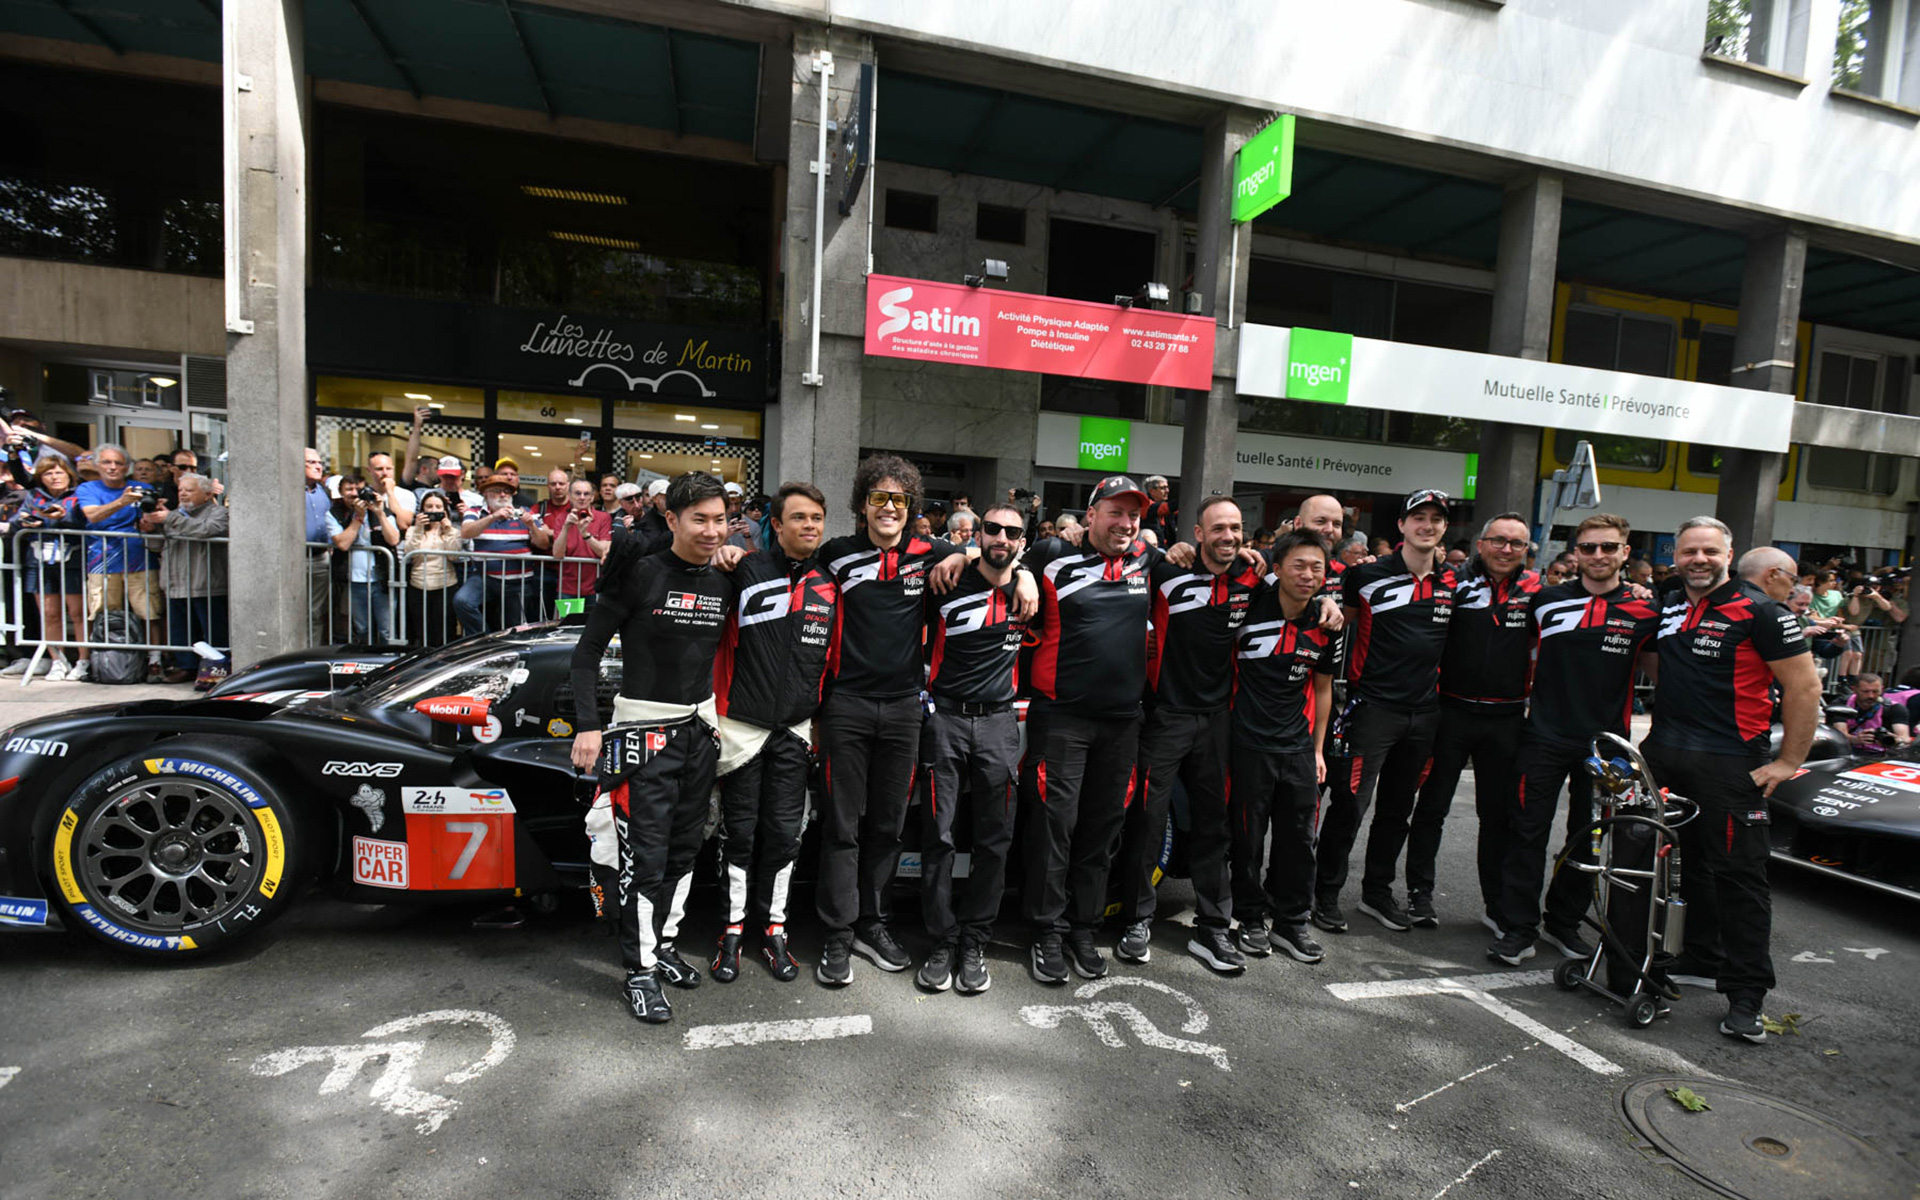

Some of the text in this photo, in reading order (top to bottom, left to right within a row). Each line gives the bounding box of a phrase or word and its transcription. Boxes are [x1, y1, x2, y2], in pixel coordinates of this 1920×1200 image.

[1237, 160, 1275, 198] mgen
[877, 286, 980, 341] Satim
[997, 311, 1110, 333] Activité Physique Adaptée
[549, 314, 584, 338] Les
[1017, 325, 1090, 342] Pompe à Insuline
[1122, 327, 1199, 344] www.satimsante.fr
[520, 322, 751, 372] Lunettes de Martin
[892, 336, 922, 346] Structure
[956, 344, 979, 353] gestion
[906, 346, 938, 355] maladies
[940, 350, 979, 360] chroniques
[1030, 339, 1075, 353] Diététique
[1131, 339, 1142, 348] 02
[1143, 340, 1154, 349] 43
[1155, 341, 1166, 350] 28
[1167, 343, 1177, 352] 77
[1290, 361, 1342, 387] mgen
[1484, 379, 1690, 419] Mutuelle Santé Prévoyance
[540, 407, 556, 418] 60
[1080, 442, 1122, 460] mgen
[1236, 450, 1392, 477] tuelle Santé Prévoyance
[564, 602, 572, 614] 7
[666, 596, 697, 610] GR
[652, 608, 693, 618] RACING
[802, 621, 828, 636] FUJITSU
[801, 636, 819, 645] Mobil
[1604, 633, 1631, 646] FUJITSU
[1694, 635, 1721, 648] FUJITSU
[1601, 645, 1621, 654] Mobil
[430, 703, 460, 715] Mobil
[481, 723, 493, 737] E
[5, 737, 69, 757] AISIN
[626, 732, 641, 765] DEN
[322, 761, 404, 777] RAYS
[1880, 767, 1920, 780] 8
[178, 761, 259, 804] MICHELIN
[1832, 779, 1898, 796] FUJITSU
[413, 790, 446, 804] 24h
[1812, 796, 1862, 810] ZENT
[1820, 788, 1880, 804] AISIN
[62, 814, 75, 831] M
[357, 841, 403, 861] HYPER
[446, 821, 489, 880] 7
[1162, 821, 1173, 865] CHELIN
[358, 857, 404, 883] CAR
[263, 878, 276, 892] M
[0, 904, 36, 917] ELIN
[80, 908, 163, 948] MICHELIN
